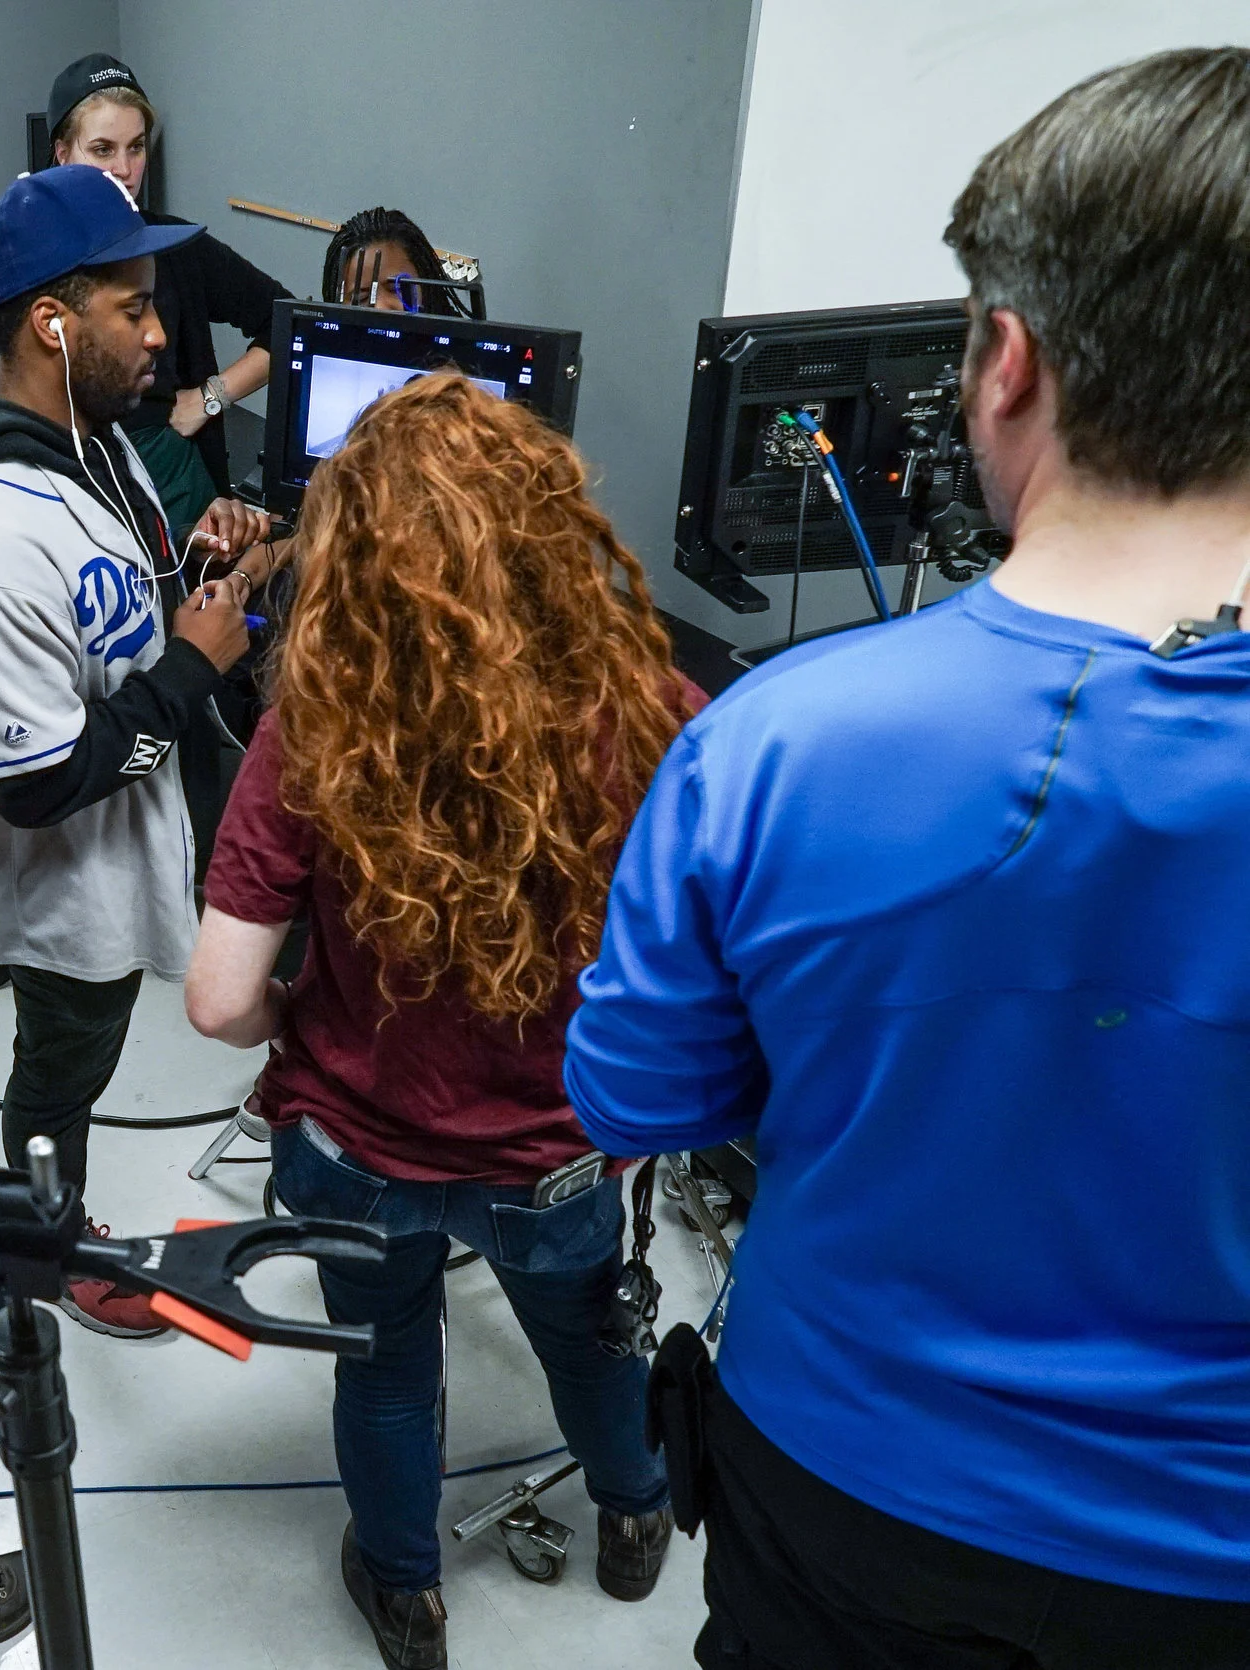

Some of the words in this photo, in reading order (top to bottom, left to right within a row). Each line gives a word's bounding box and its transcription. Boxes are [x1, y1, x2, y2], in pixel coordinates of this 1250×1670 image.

[322, 322, 340, 331] 23.976
[386, 330, 400, 339] 180.0
[438, 336, 450, 345] 800
[483, 342, 498, 351] 2700
